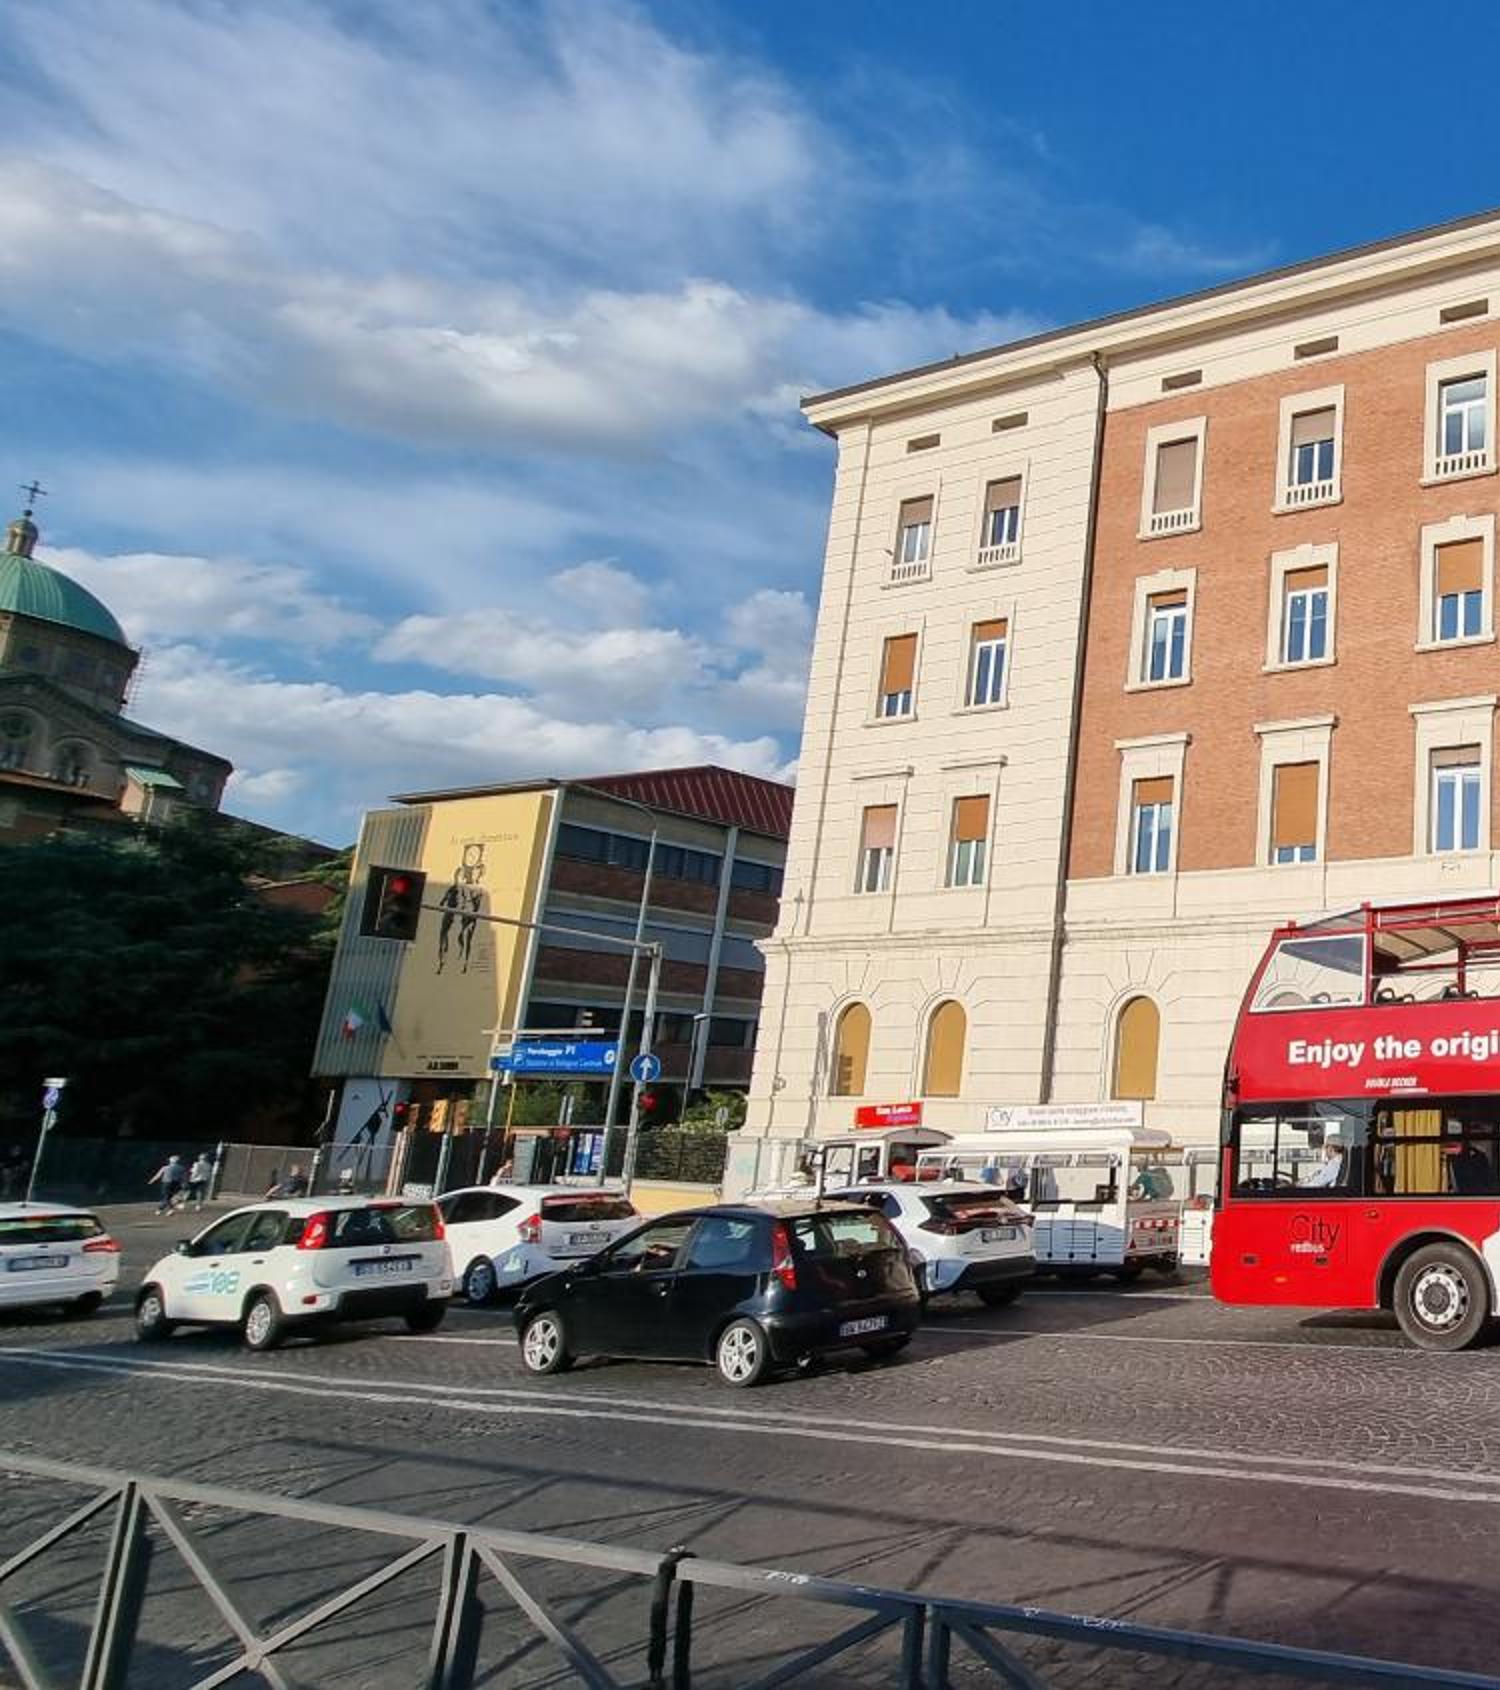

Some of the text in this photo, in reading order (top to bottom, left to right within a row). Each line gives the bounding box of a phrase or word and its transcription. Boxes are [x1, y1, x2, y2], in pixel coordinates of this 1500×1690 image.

[1288, 1038, 1365, 1068] Enjoy
[1374, 1034, 1421, 1059] the
[1291, 1214, 1340, 1251] City
